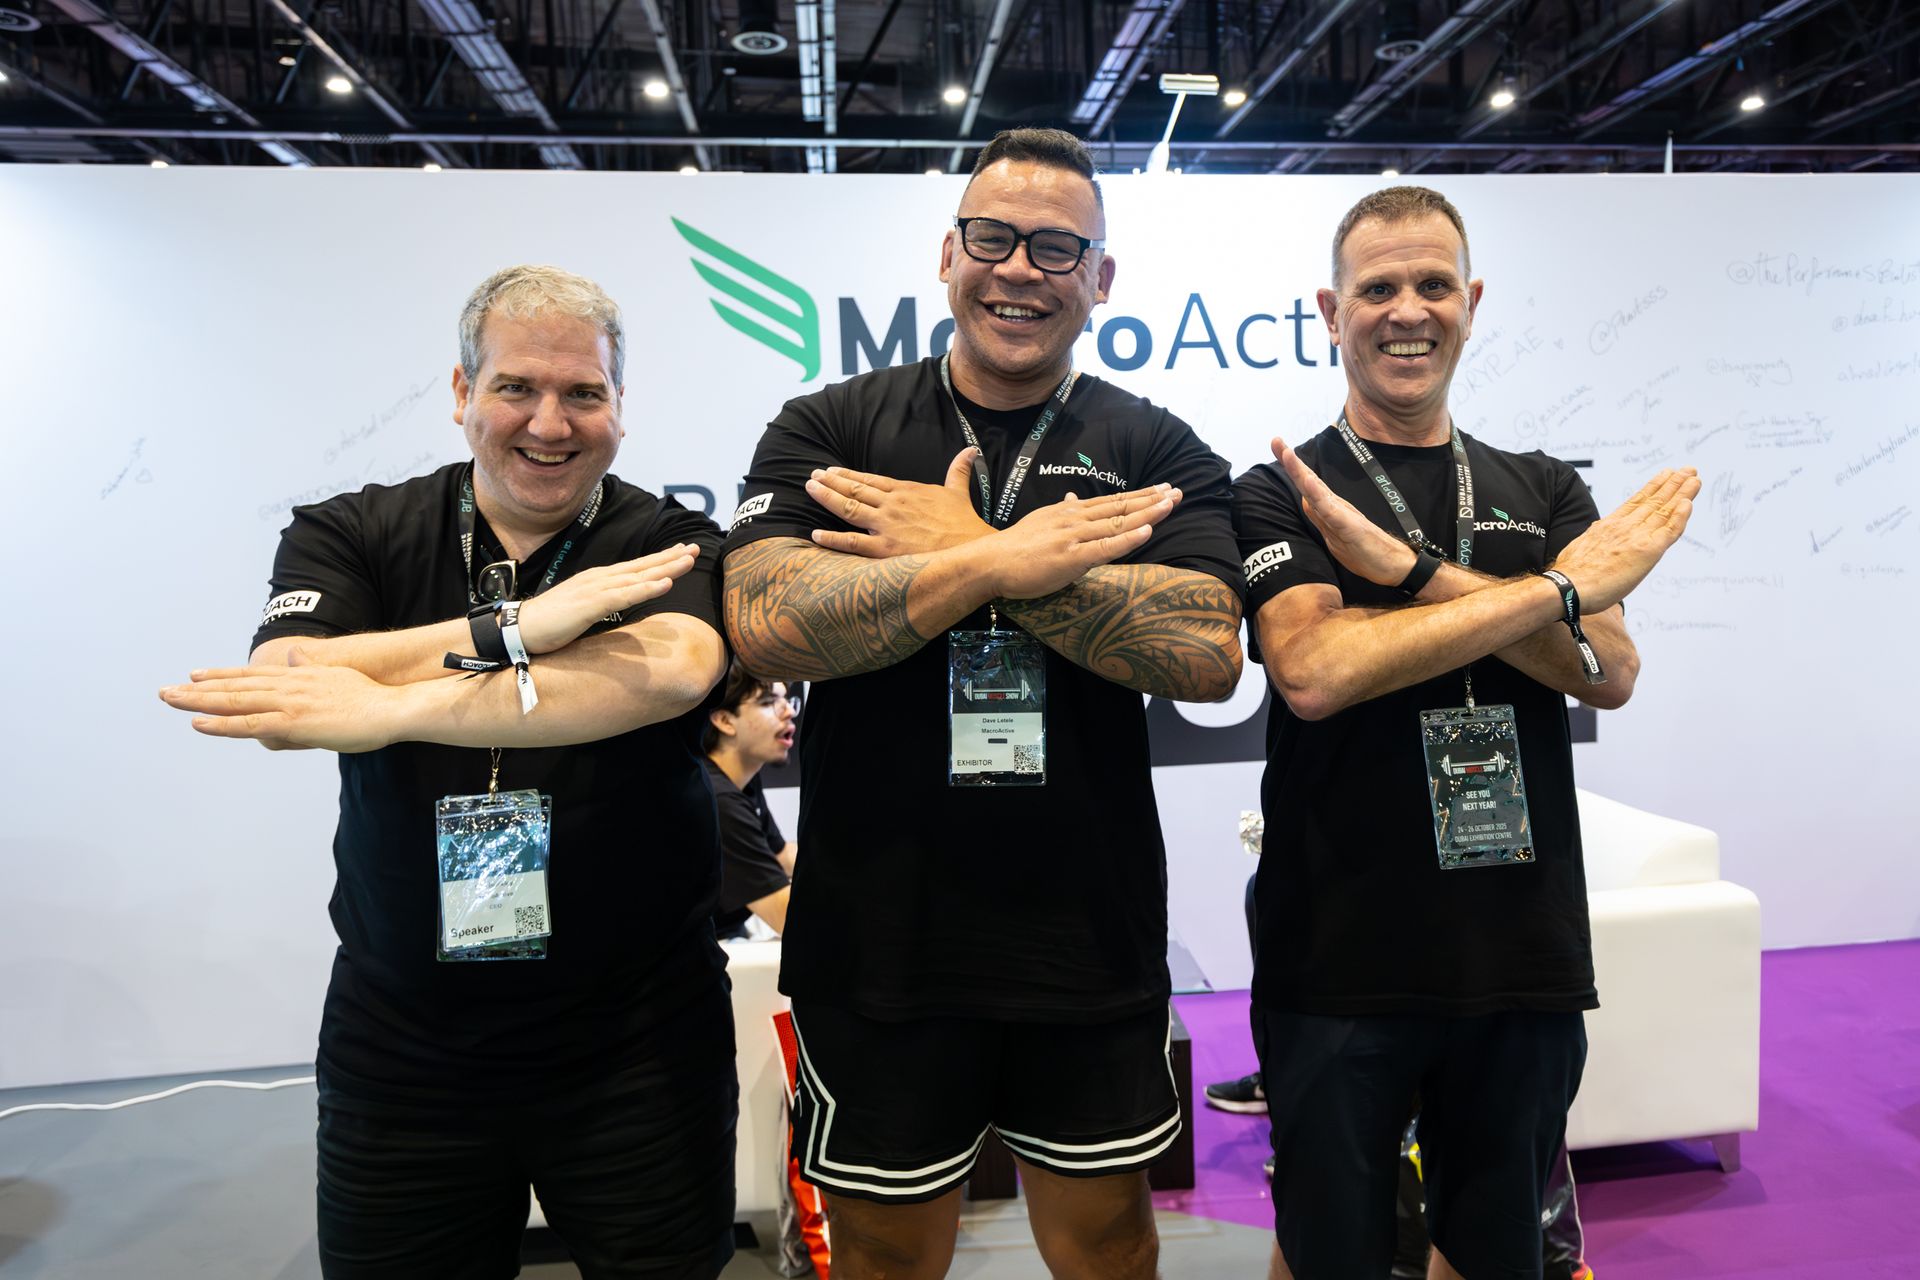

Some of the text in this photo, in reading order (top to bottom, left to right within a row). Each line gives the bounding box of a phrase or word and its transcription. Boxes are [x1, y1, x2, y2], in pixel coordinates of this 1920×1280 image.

[1345, 426, 1374, 461] DUBAI ACTIVE
[1347, 440, 1367, 464] INDUSTRY
[1039, 463, 1128, 490] MacroActive
[1457, 464, 1465, 485] ACTIVE
[1464, 466, 1473, 496] INDUSTRY
[996, 480, 1014, 520] INDUSTRY
[1002, 468, 1027, 522] DUBAI ACTIVE
[1473, 519, 1547, 539] acroActive
[1461, 538, 1472, 565] cryo
[506, 608, 518, 626] VIP
[1466, 790, 1491, 799] SEE YOU
[1462, 801, 1497, 811] NEXT YEAR!
[1467, 825, 1474, 833] 26
[1475, 824, 1495, 832] OCTOBER
[1470, 833, 1494, 842] EXHIBITION
[451, 924, 494, 938] Speaker
